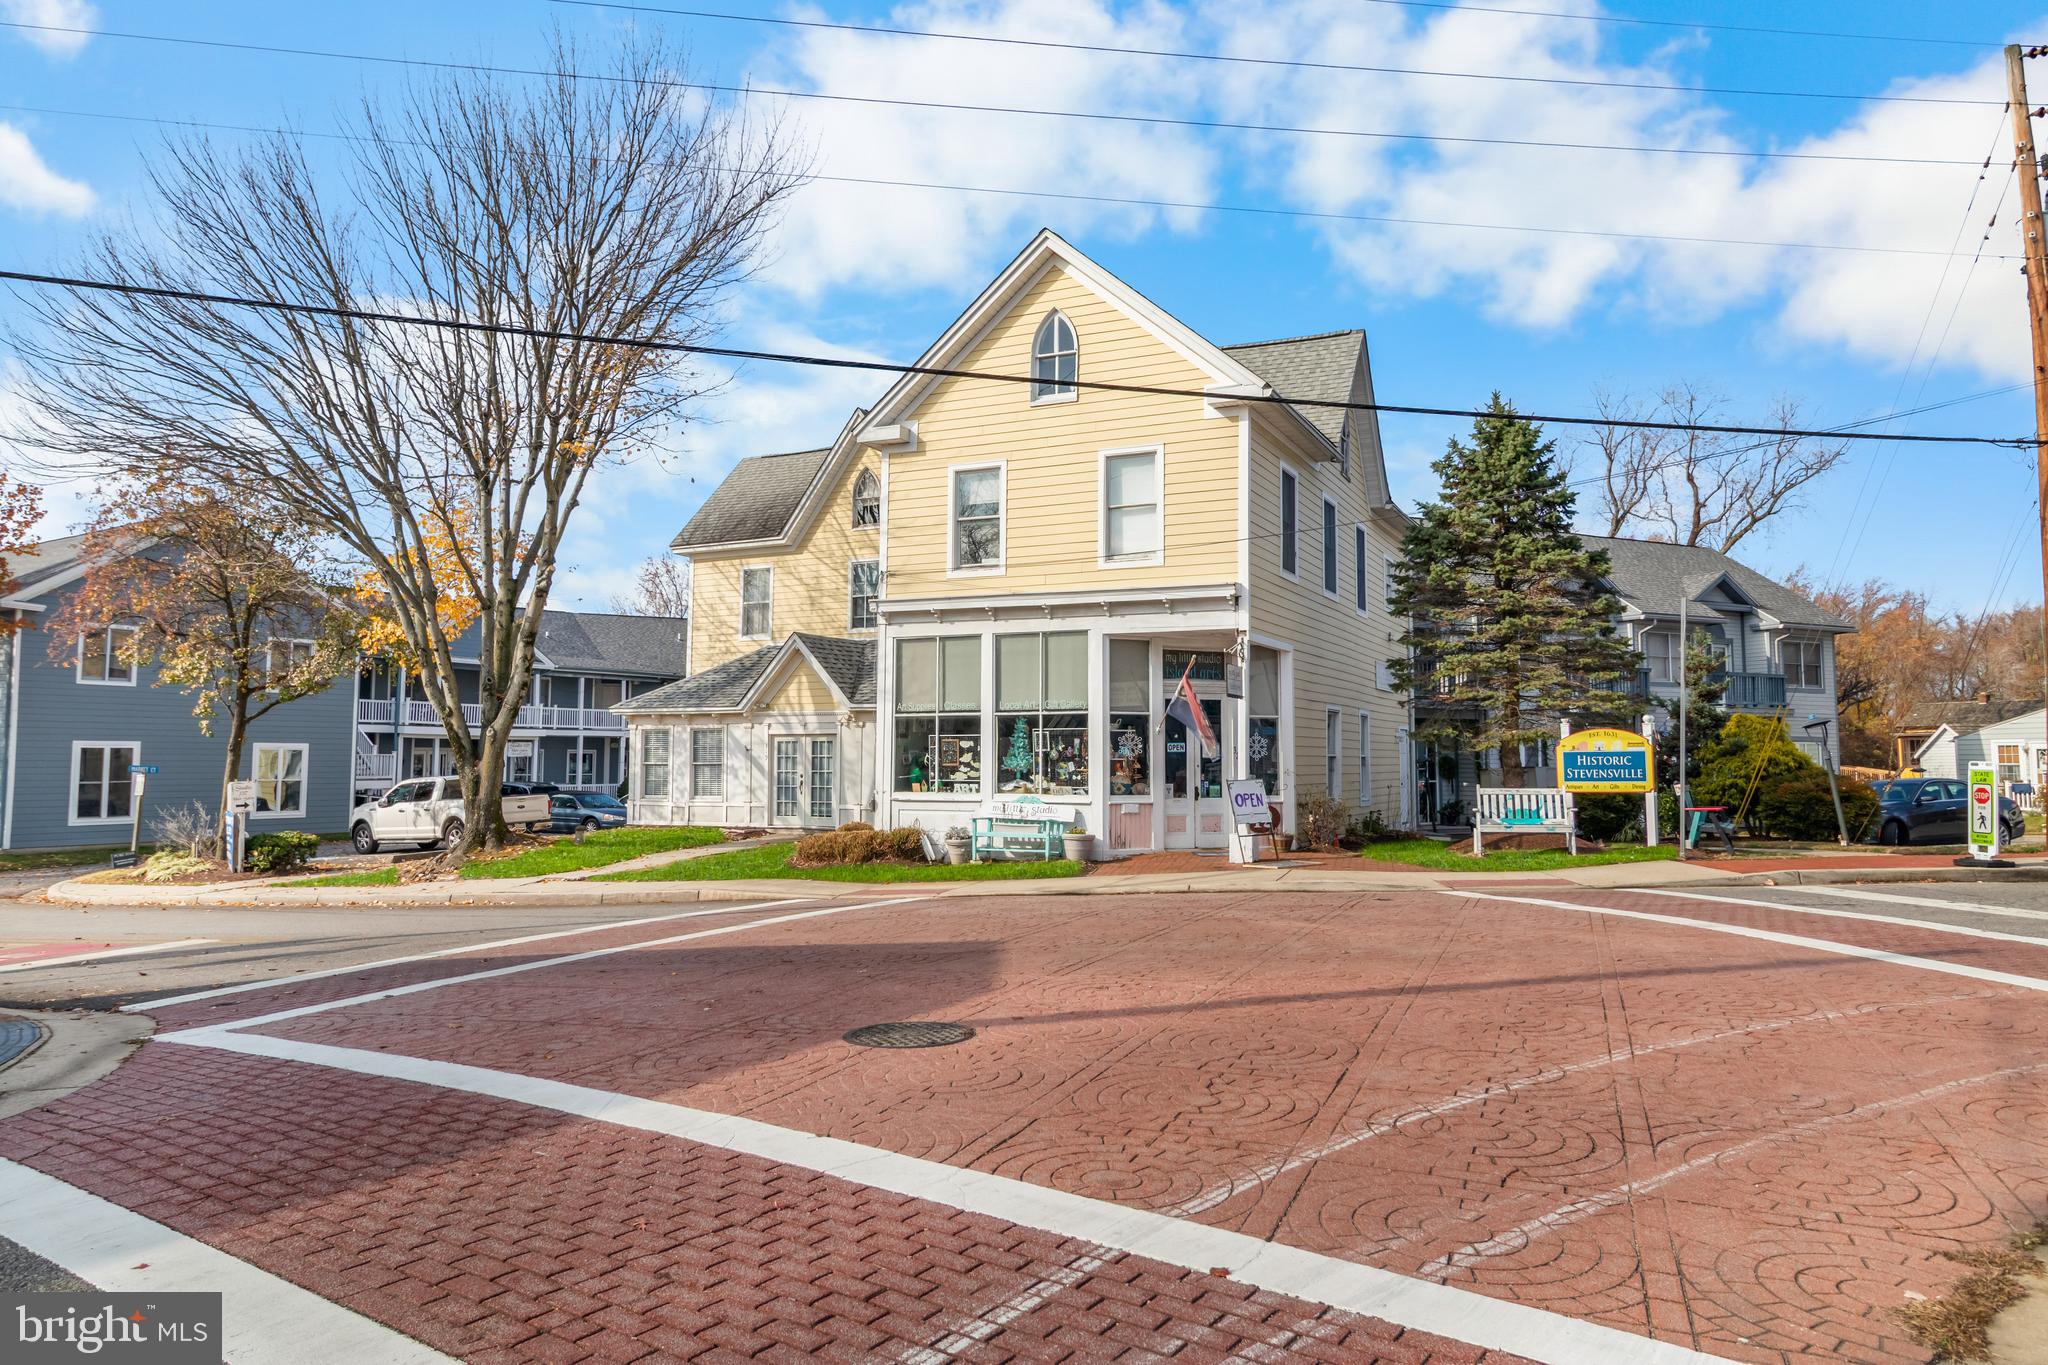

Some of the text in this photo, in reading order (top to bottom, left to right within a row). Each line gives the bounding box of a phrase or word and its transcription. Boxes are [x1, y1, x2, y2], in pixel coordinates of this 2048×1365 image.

[1198, 652, 1221, 664] studio
[1577, 755, 1632, 766] HISTORIC
[1567, 768, 1643, 779] STEVENSVILLE
[953, 783, 979, 793] ART
[1234, 792, 1264, 808] OPEN
[1974, 792, 1990, 800] STOP
[1031, 805, 1058, 815] studio
